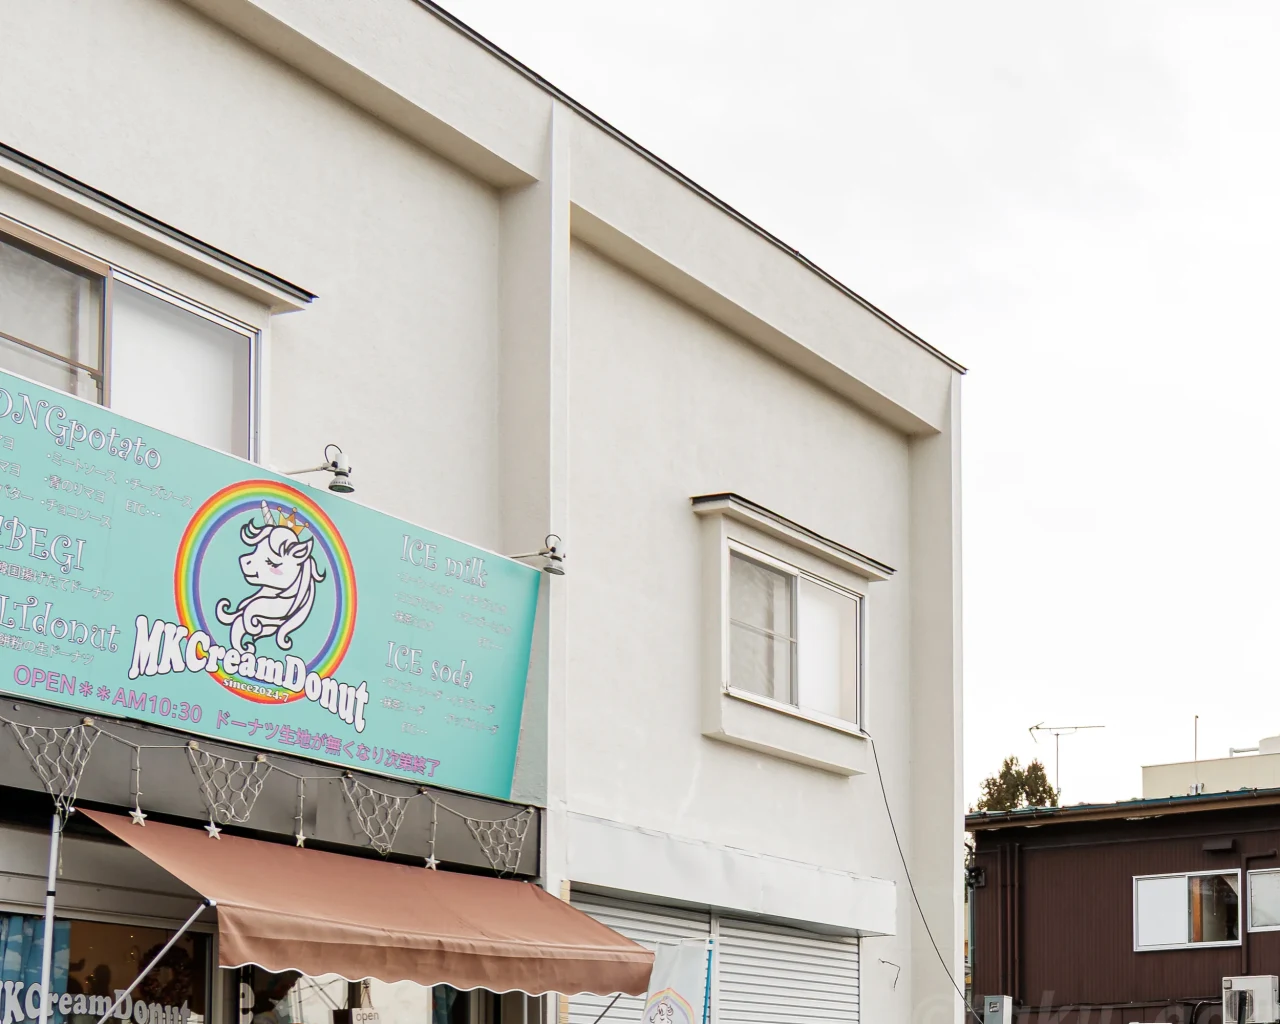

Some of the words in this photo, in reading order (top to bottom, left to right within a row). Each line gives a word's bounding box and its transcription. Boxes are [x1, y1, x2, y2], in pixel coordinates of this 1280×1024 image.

[0, 515, 86, 574] BEGI
[401, 534, 437, 571] ICE
[445, 557, 488, 588] milk
[385, 641, 423, 676] ICE
[431, 660, 473, 689] soda
[216, 710, 440, 777] ドーナツ生地が無くなり次第終了
[356, 1012, 379, 1024] open
